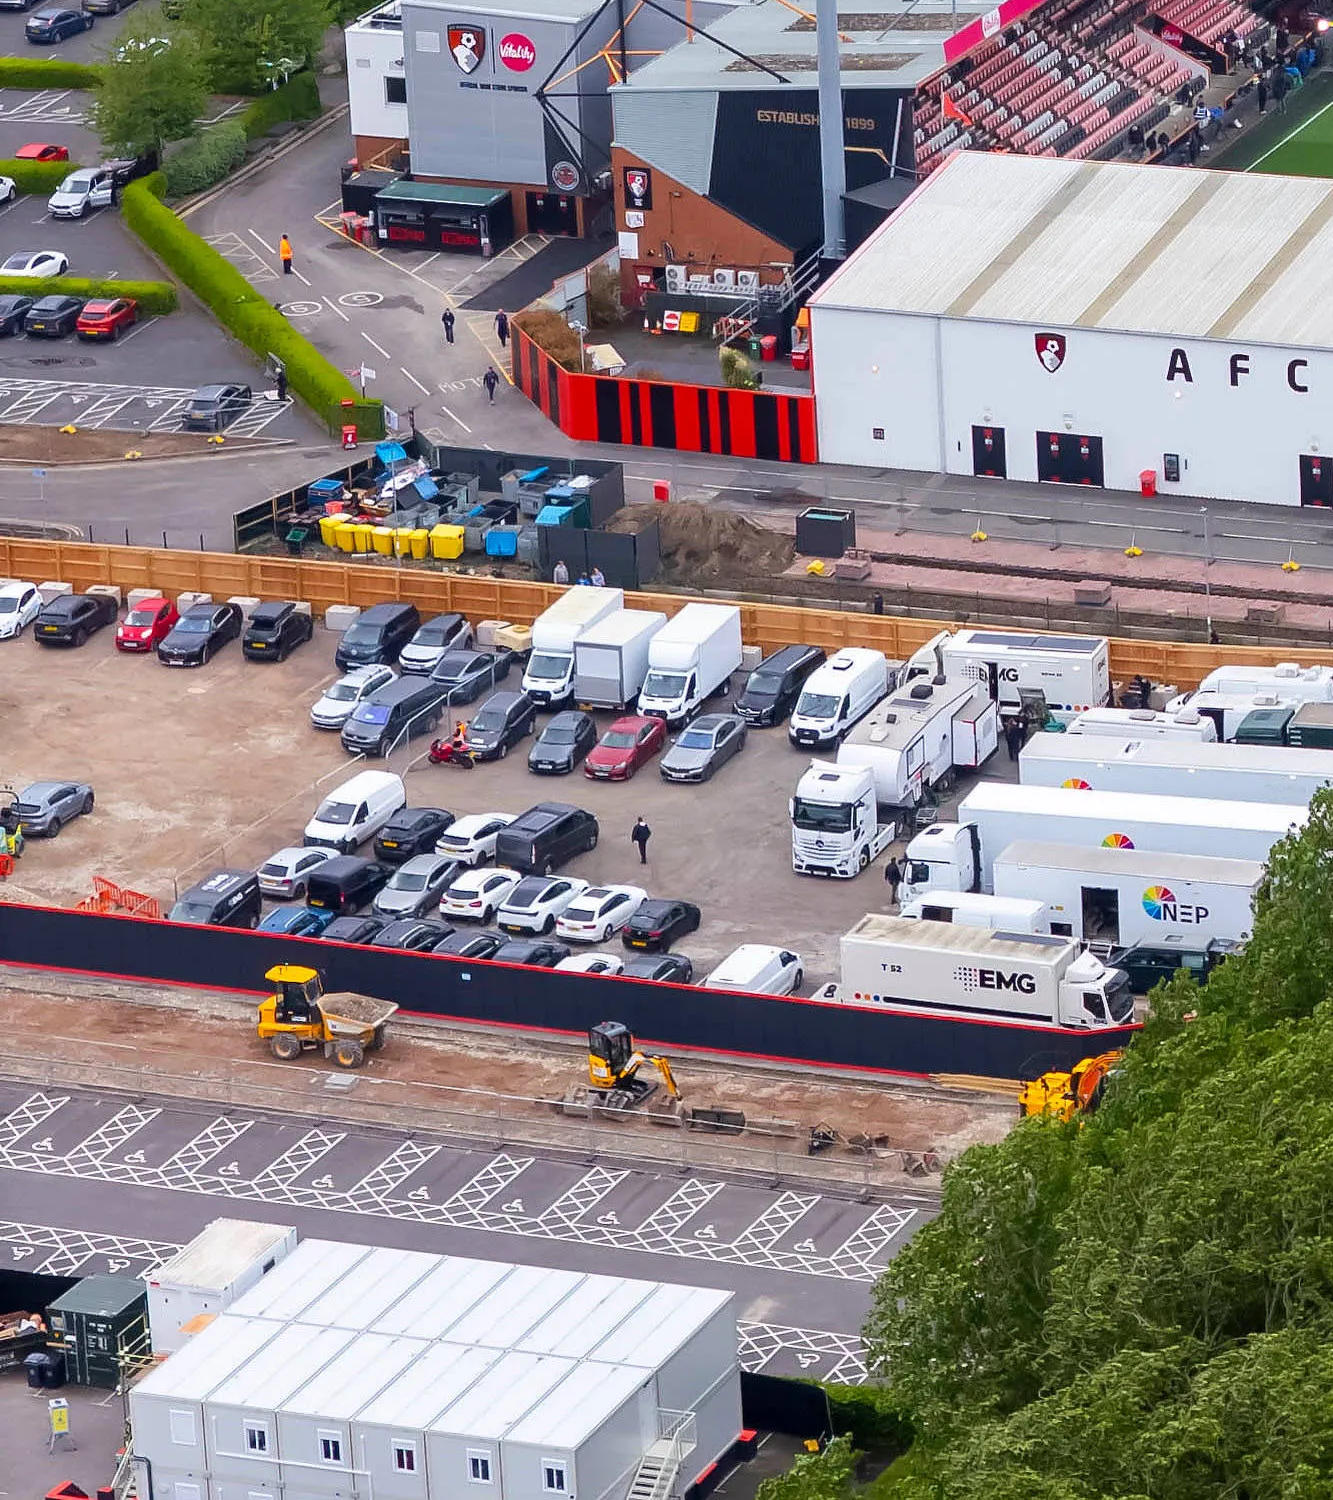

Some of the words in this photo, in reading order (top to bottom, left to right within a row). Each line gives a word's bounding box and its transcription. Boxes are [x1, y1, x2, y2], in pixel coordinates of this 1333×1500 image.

[500, 42, 534, 64] Vitality
[846, 117, 876, 130] 1899
[1166, 348, 1309, 393] AFC
[1163, 903, 1209, 924] NEP
[890, 965, 902, 973] 52
[979, 969, 1036, 994] EMG
